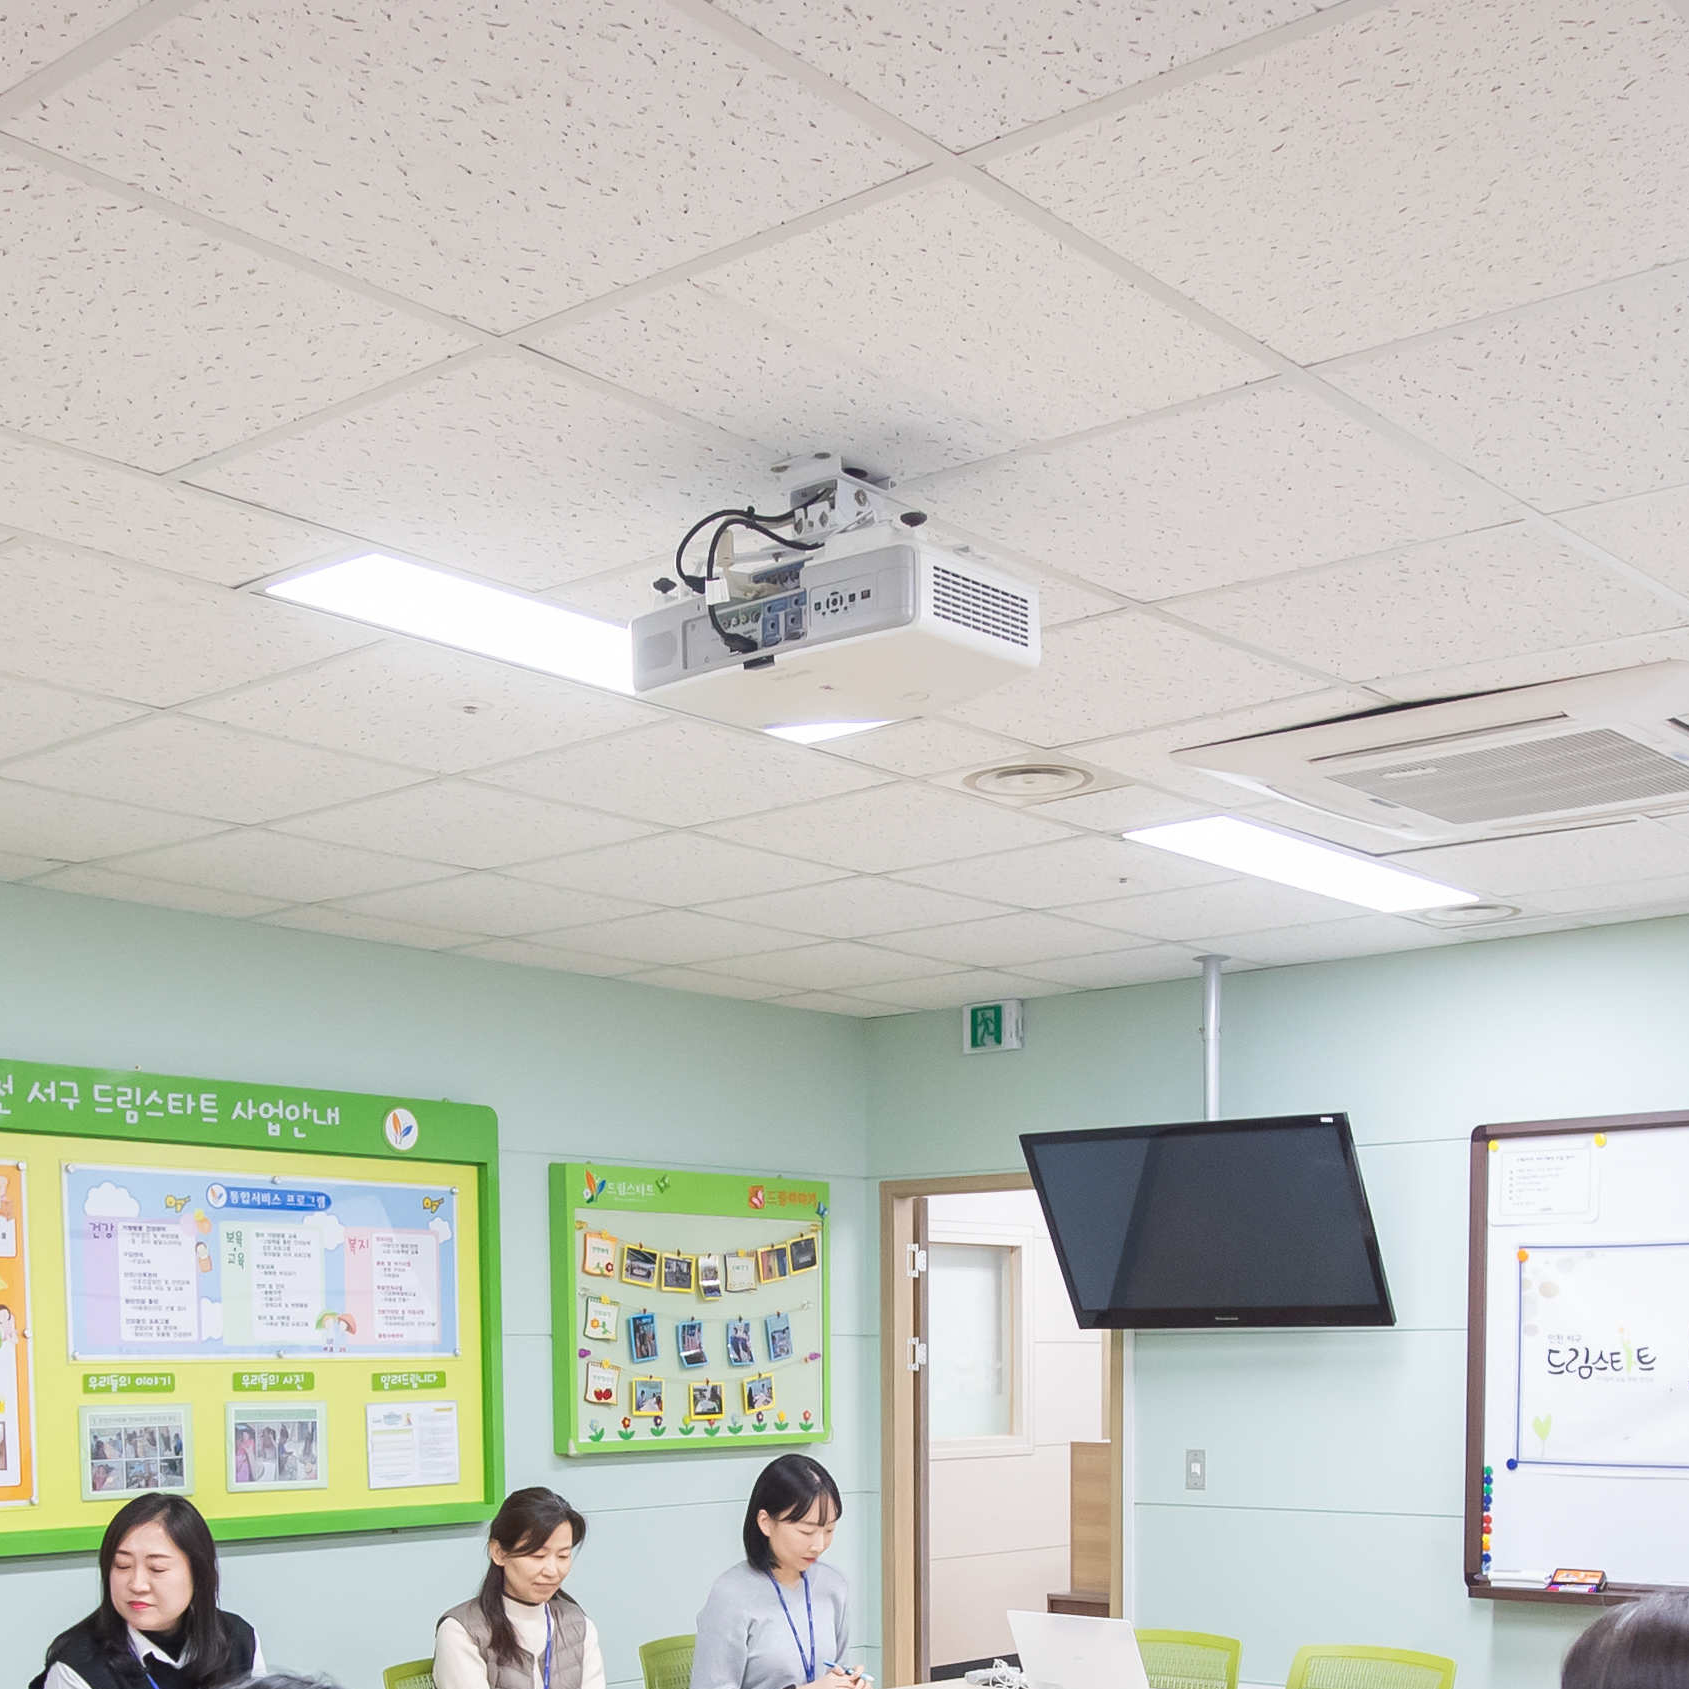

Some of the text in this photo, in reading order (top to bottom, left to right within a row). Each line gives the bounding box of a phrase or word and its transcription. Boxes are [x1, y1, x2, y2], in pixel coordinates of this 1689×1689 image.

[27, 1080, 81, 1110] 서구
[93, 1084, 219, 1125] 드림스타트
[231, 1098, 341, 1139] 사업안내
[229, 1191, 326, 1209] 통합서비스 프로그램
[88, 1222, 114, 1239] 건강
[348, 1236, 369, 1256] 복지
[88, 1375, 171, 1391] 우리들의 이야기
[241, 1374, 305, 1391] 우리들의 사진
